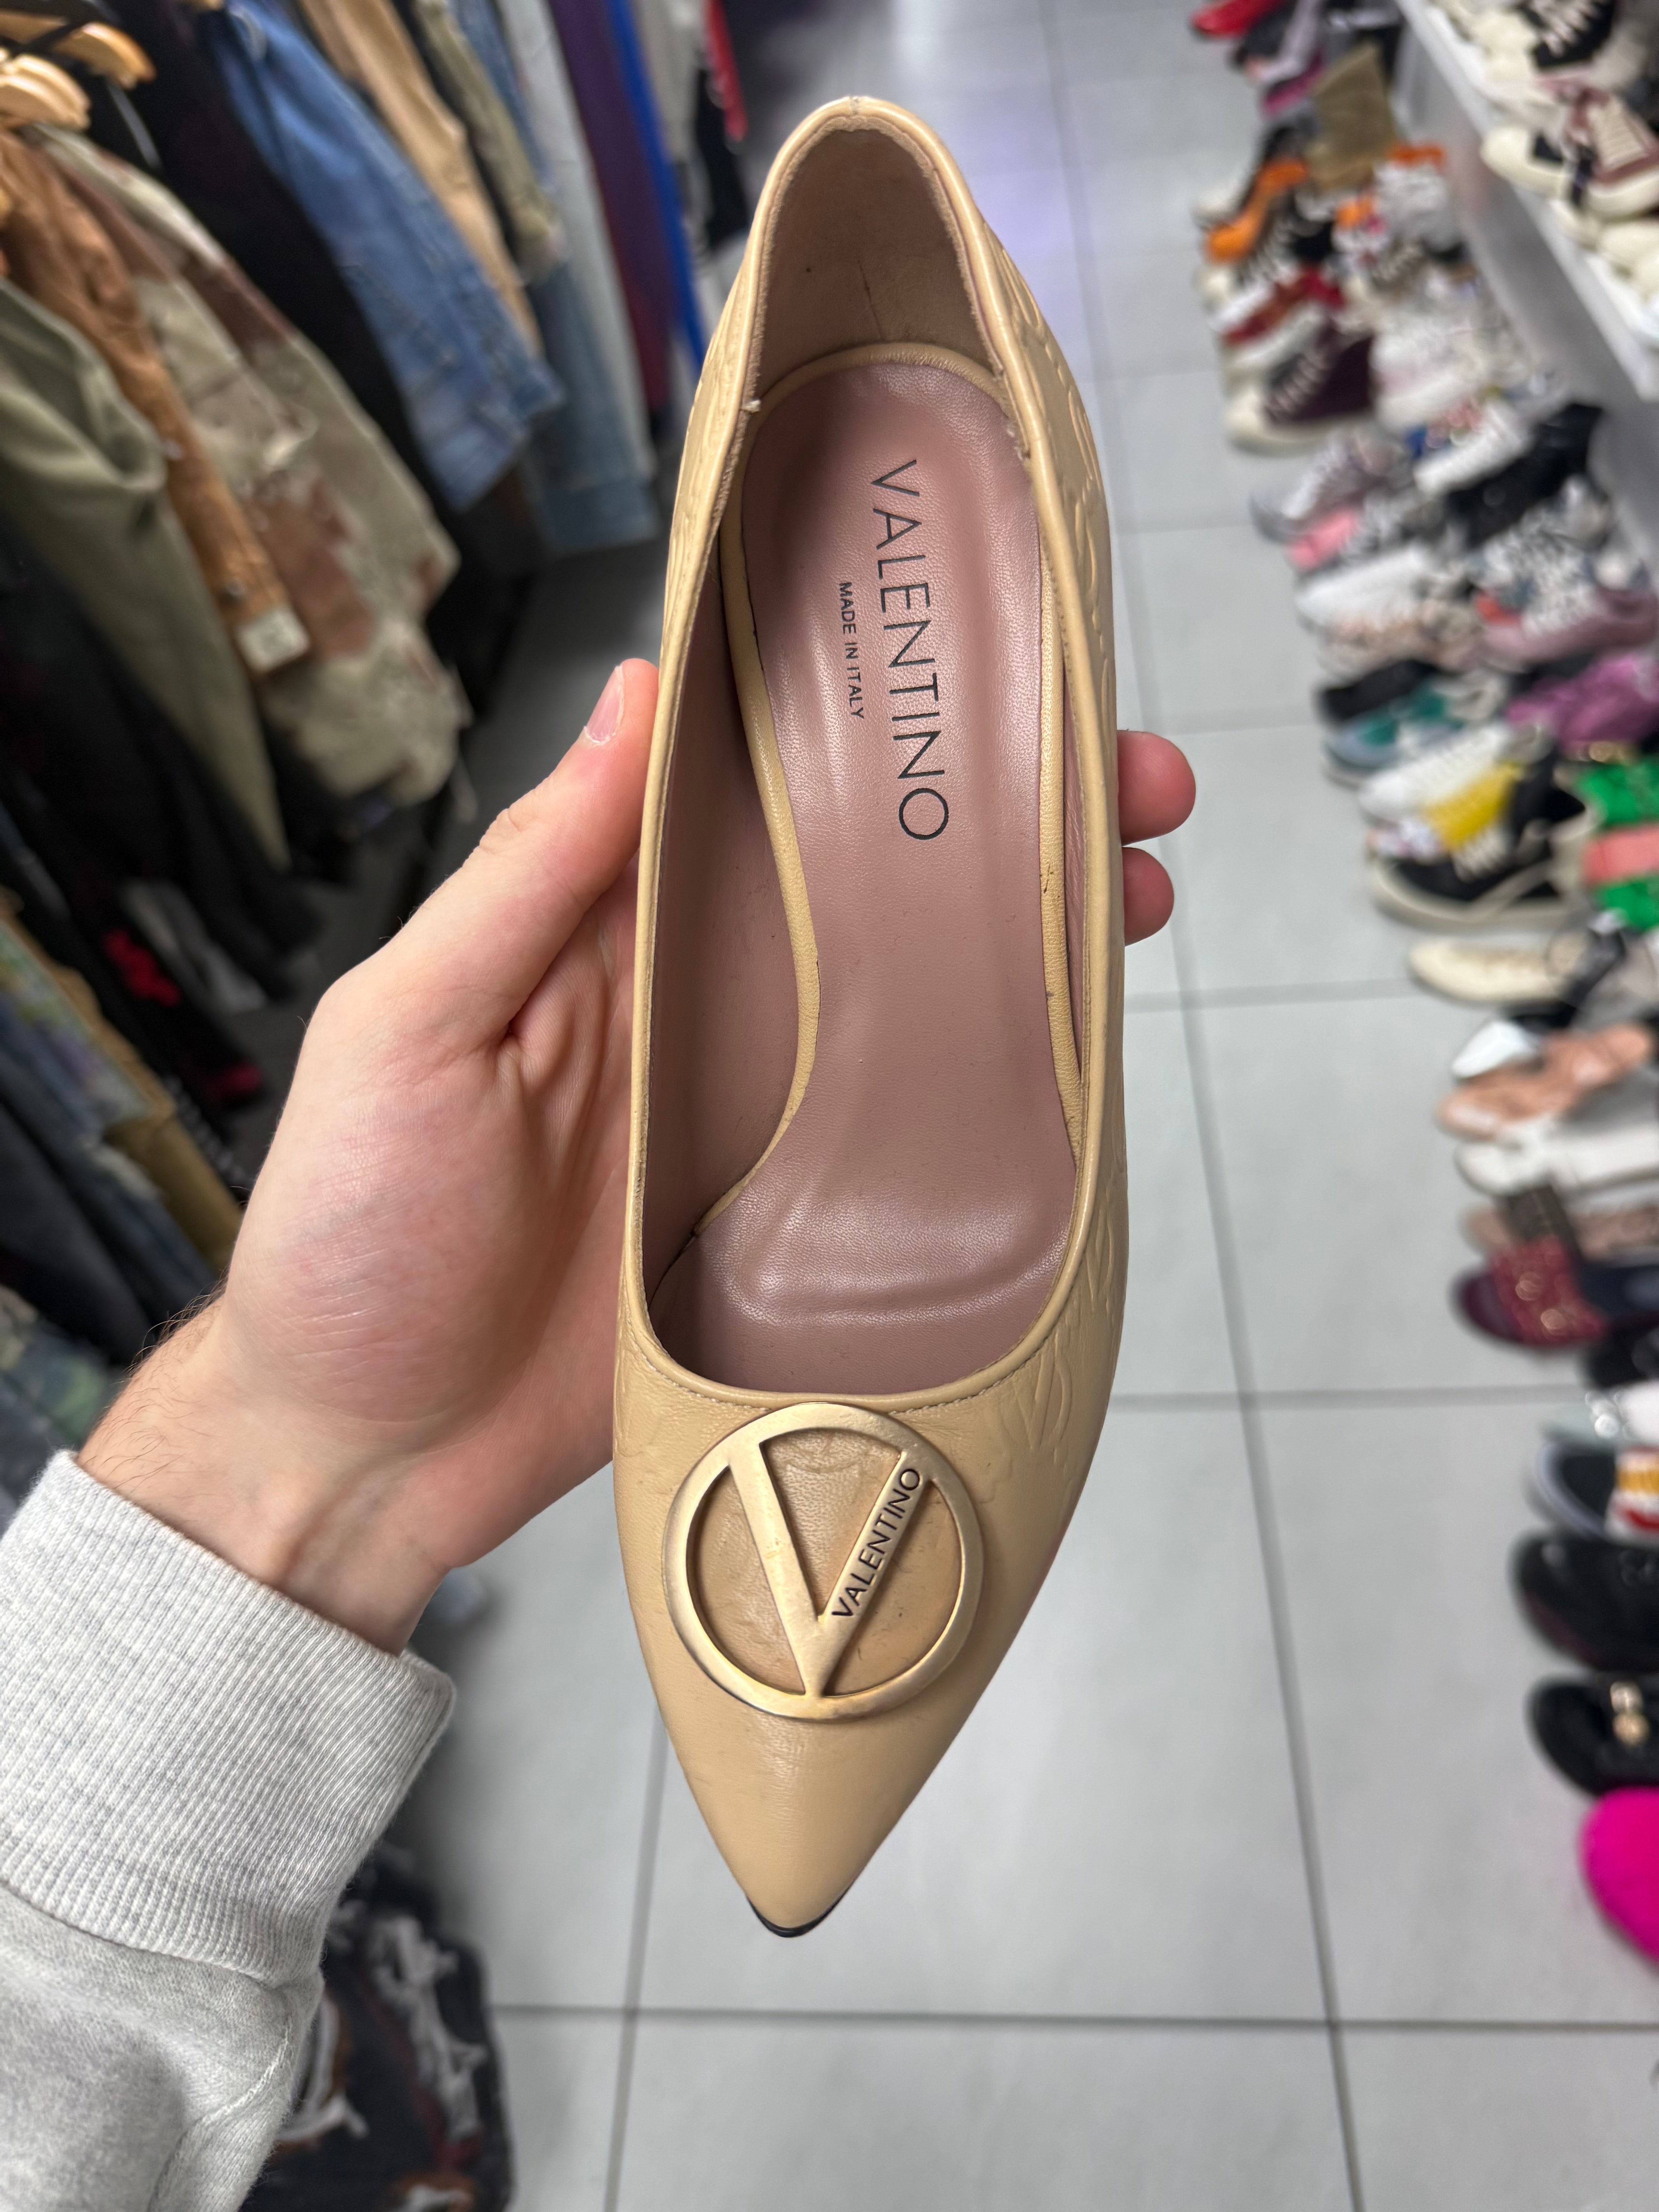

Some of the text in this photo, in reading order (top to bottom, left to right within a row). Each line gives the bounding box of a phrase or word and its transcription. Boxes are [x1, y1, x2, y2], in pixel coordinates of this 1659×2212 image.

[838, 581, 864, 720] MADE IN ITALY
[870, 459, 950, 842] VALENTINO
[831, 1467, 921, 1617] VALENTINO
